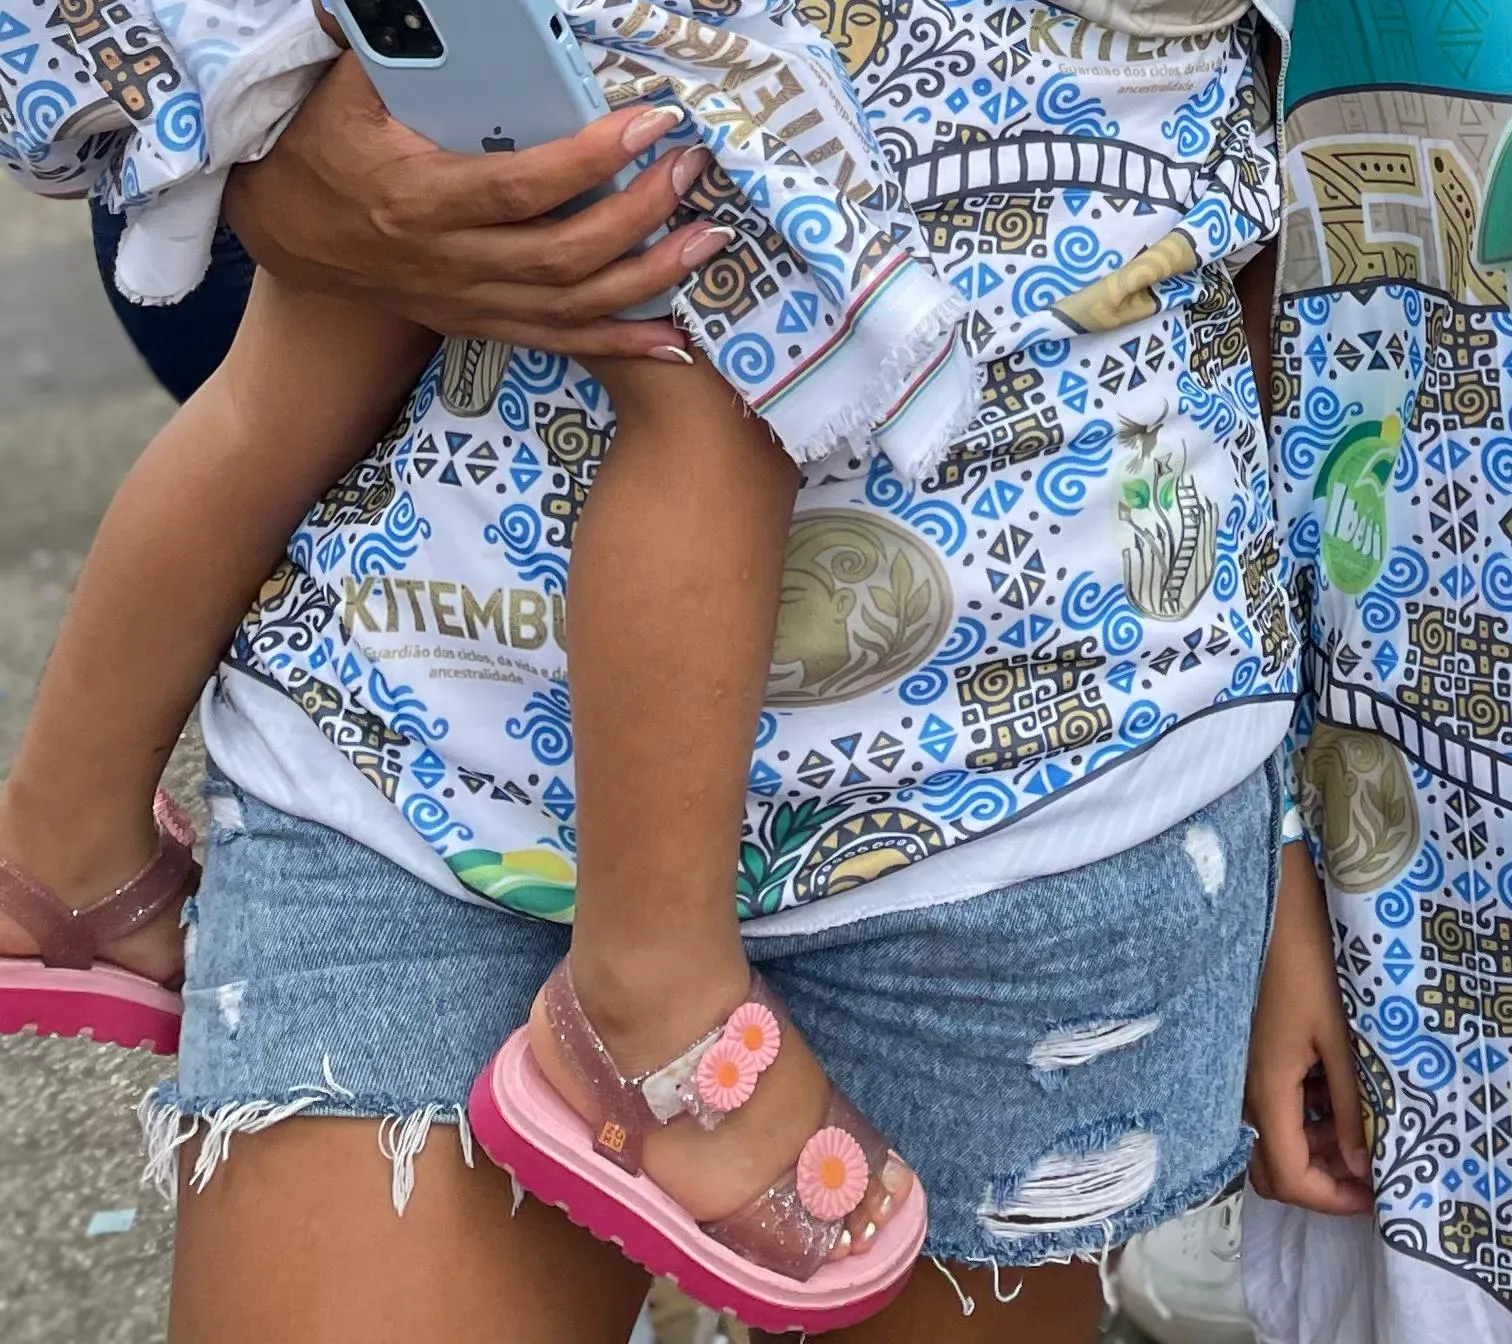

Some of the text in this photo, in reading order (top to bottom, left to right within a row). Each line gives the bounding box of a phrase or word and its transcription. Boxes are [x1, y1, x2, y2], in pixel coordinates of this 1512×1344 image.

[1124, 64, 1147, 78] dos
[364, 645, 430, 660] Guardião
[434, 645, 455, 659] dos
[429, 666, 524, 685] ancestralidade
